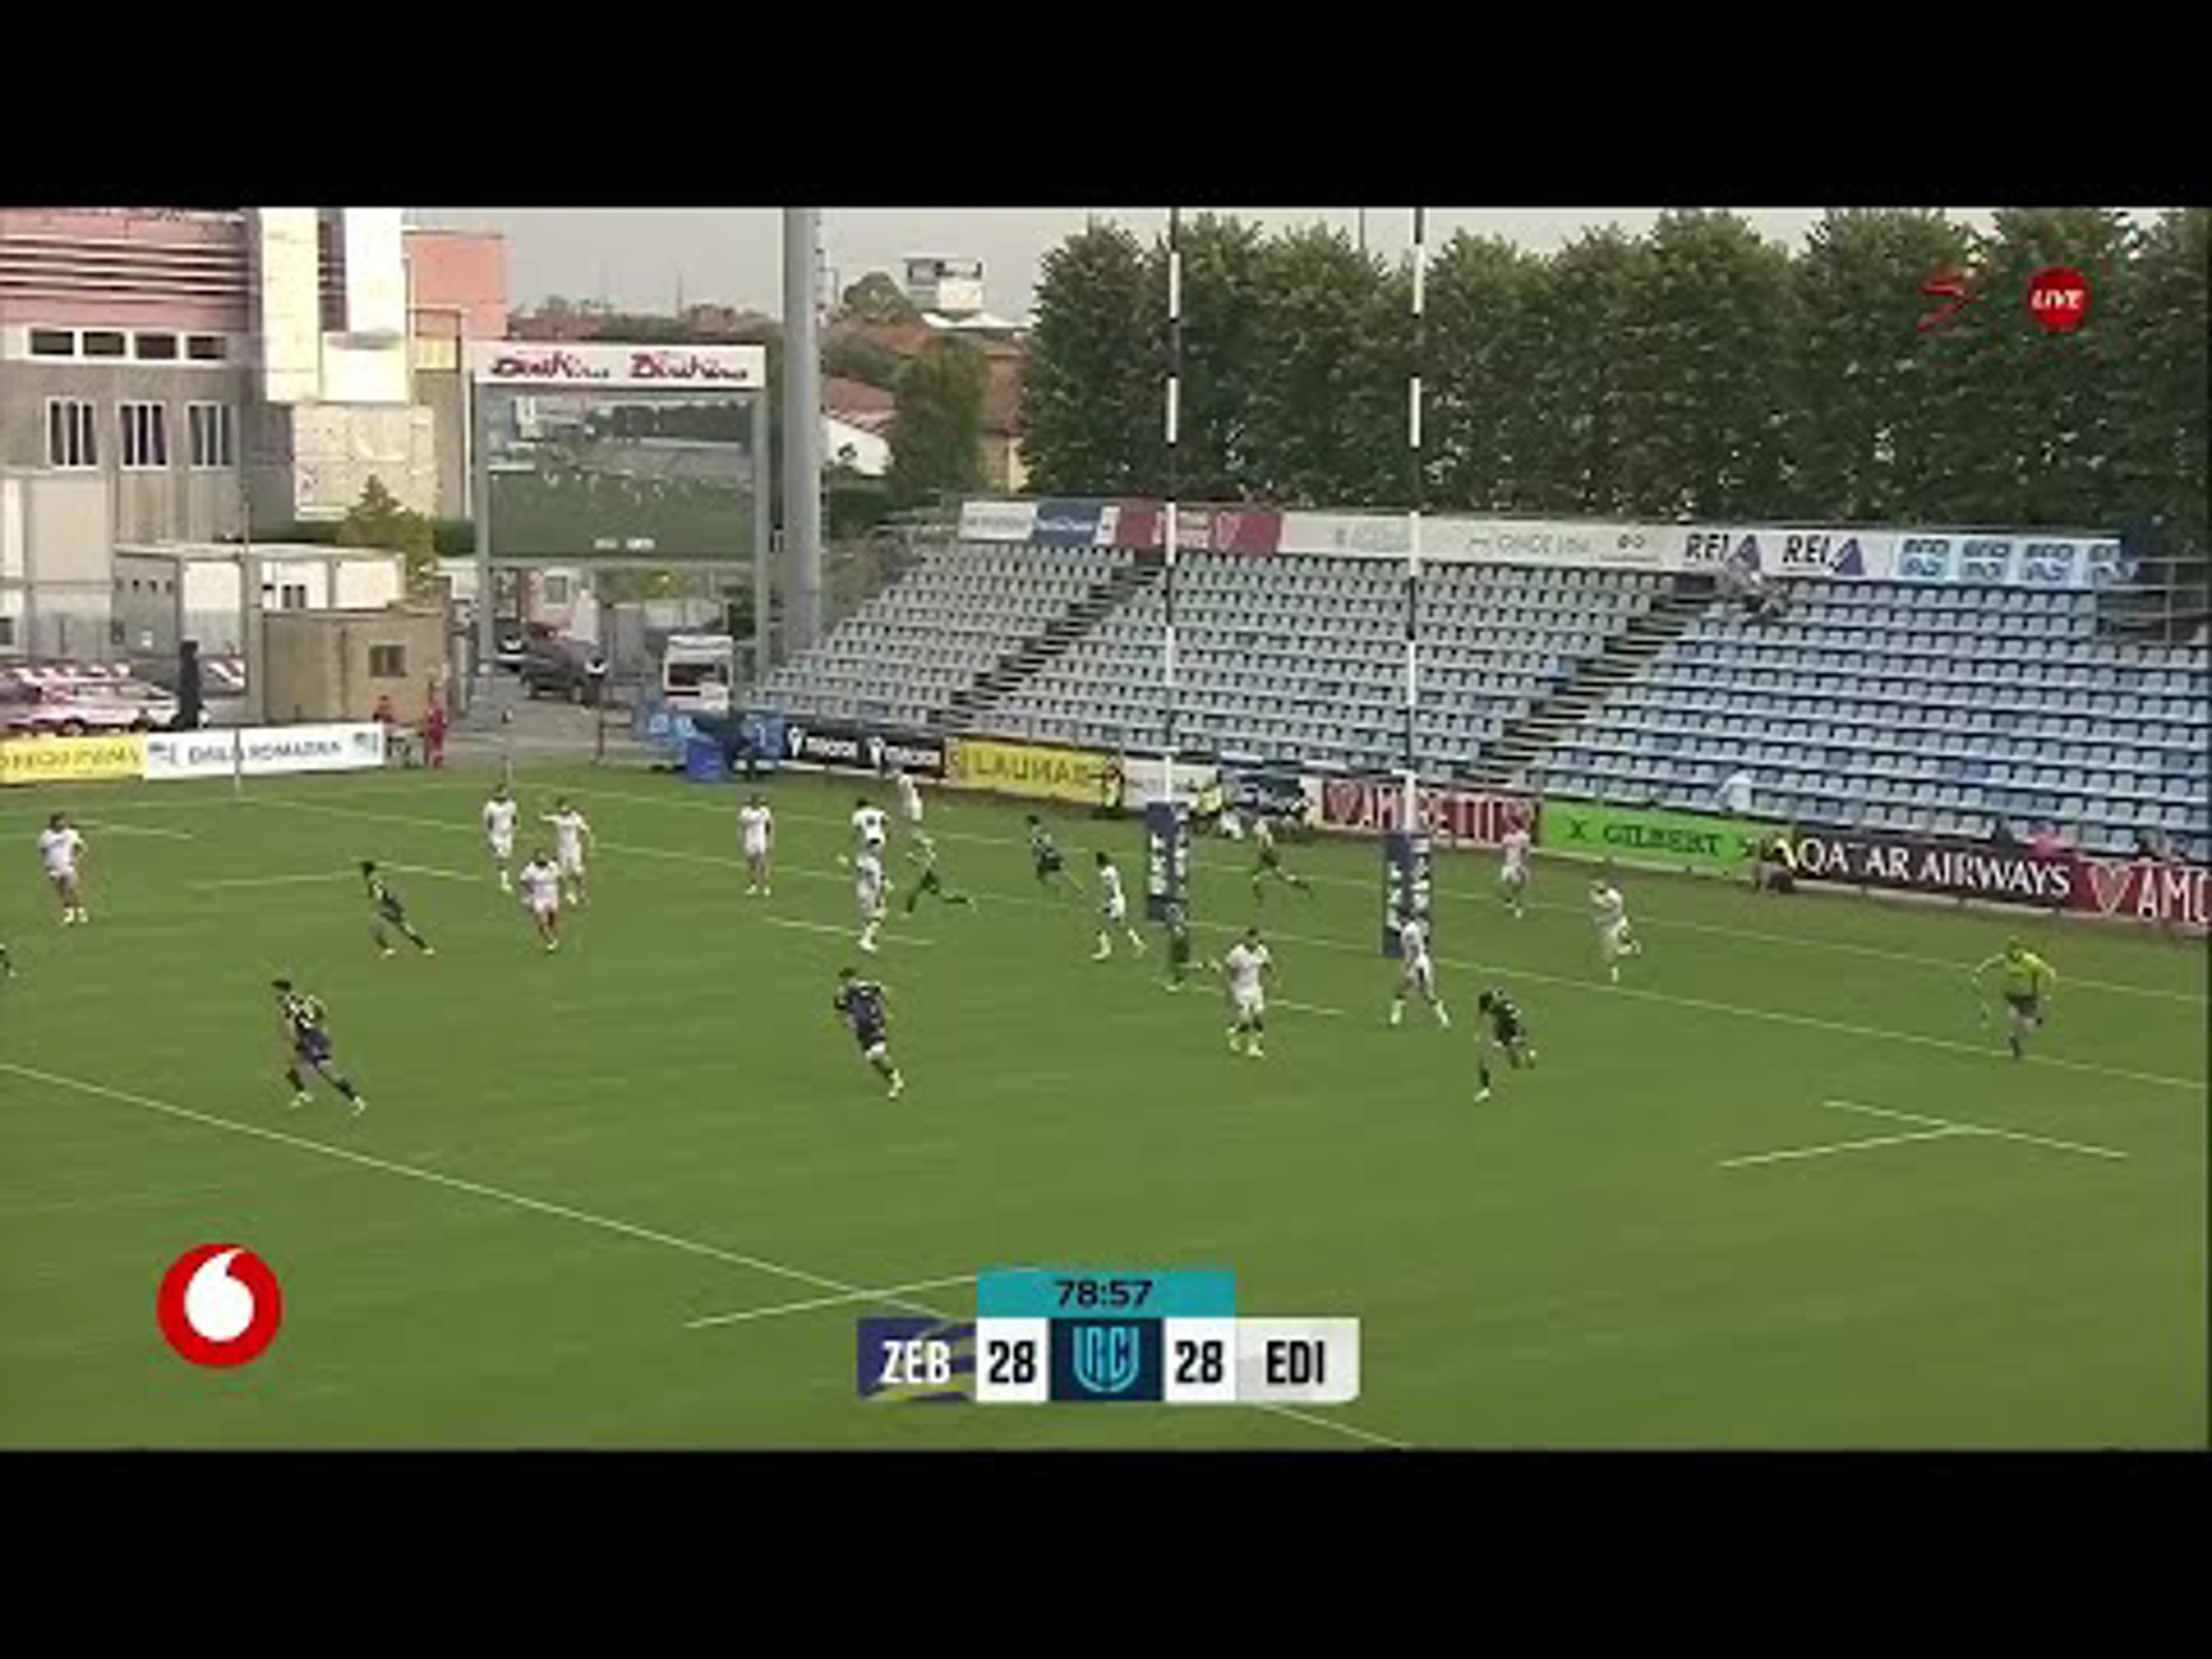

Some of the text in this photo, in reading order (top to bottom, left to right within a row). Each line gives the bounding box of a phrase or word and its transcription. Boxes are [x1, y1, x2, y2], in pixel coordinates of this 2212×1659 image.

[1360, 782, 1495, 842] AMRETTI
[1603, 824, 1724, 857] GILBERT
[1917, 853, 2070, 897] AIRWAYS
